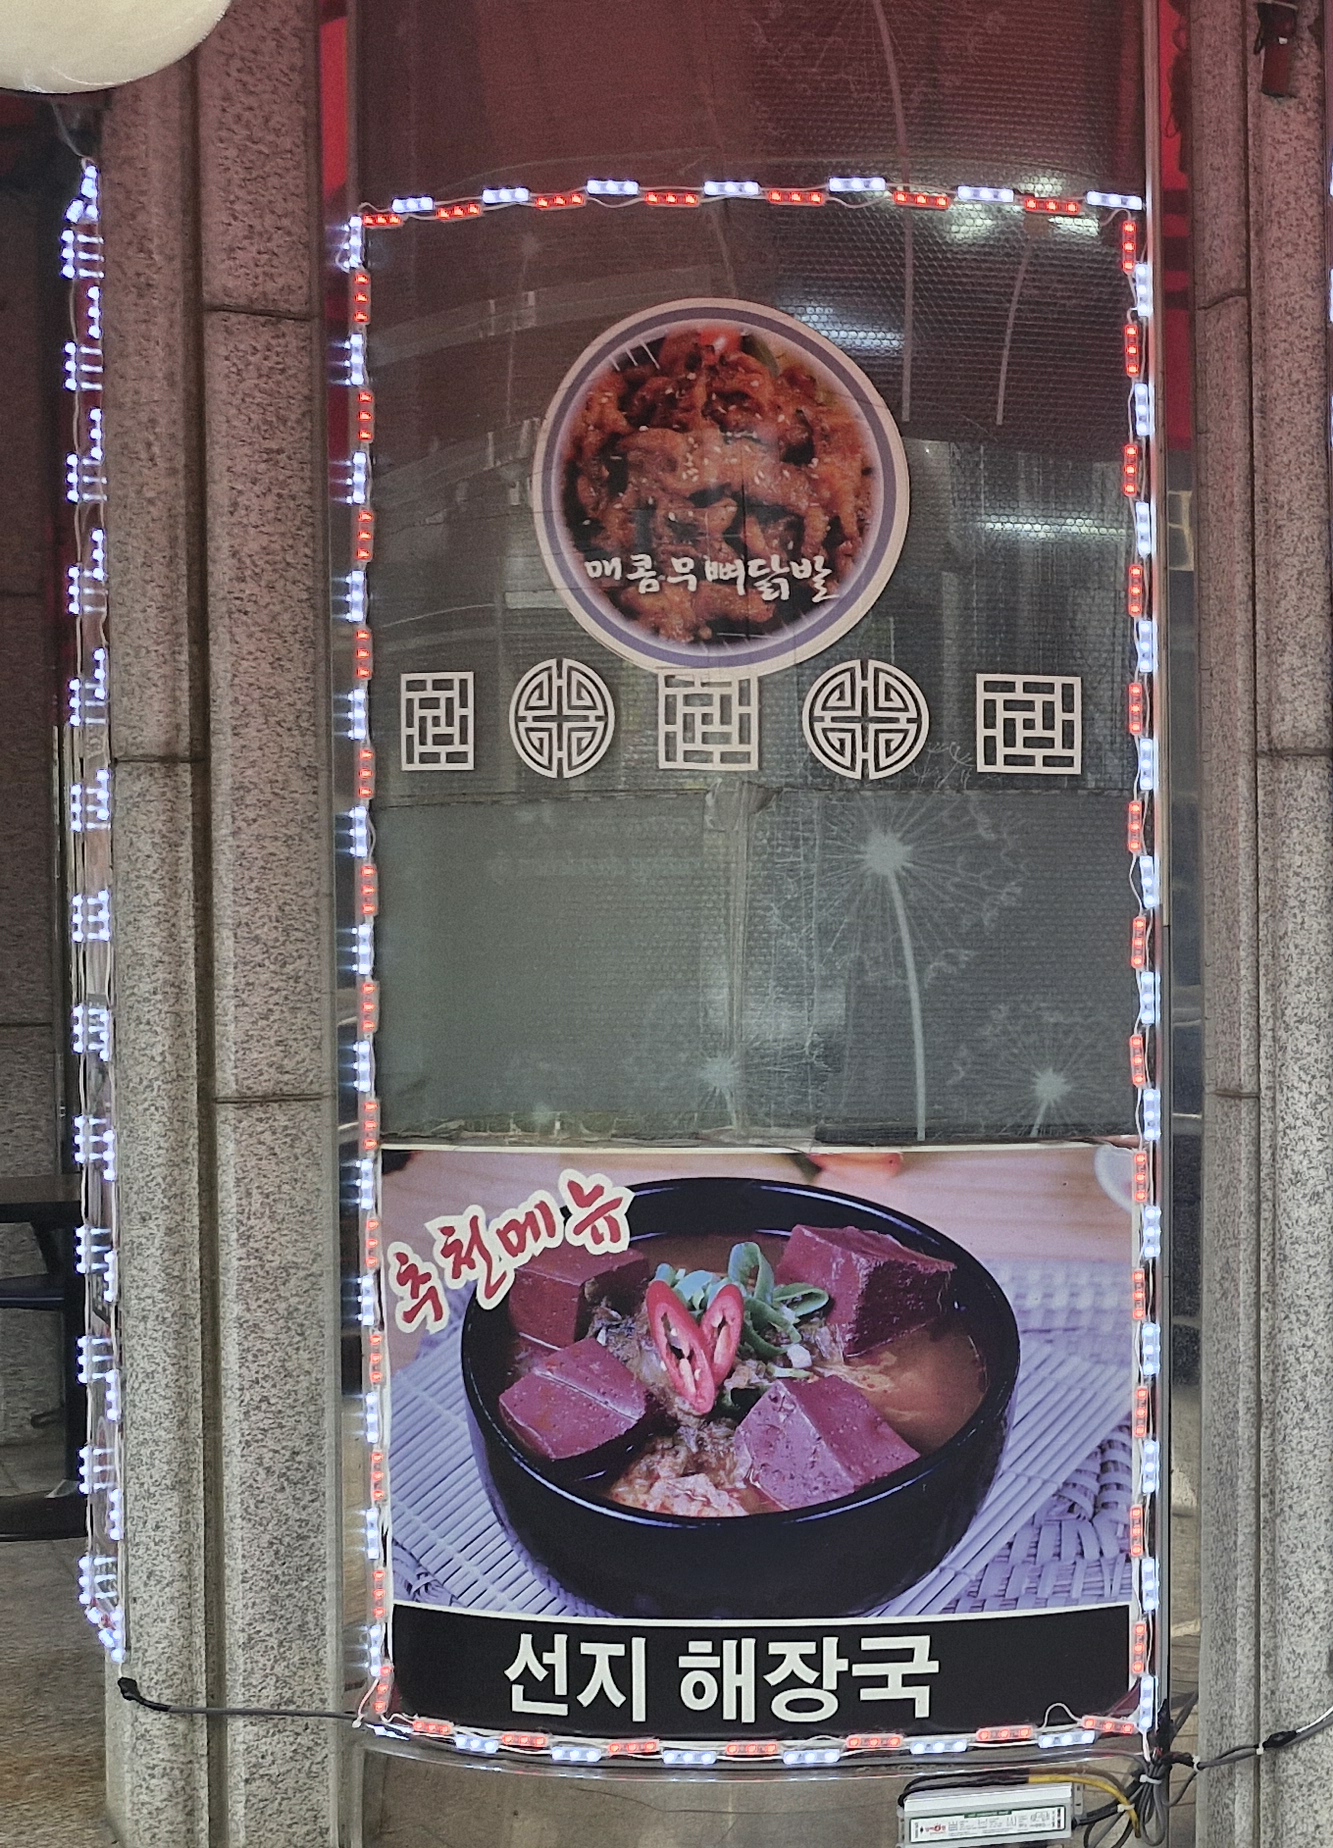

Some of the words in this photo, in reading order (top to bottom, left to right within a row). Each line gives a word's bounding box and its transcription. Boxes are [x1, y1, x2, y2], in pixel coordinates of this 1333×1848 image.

[393, 1171, 633, 1329] 추천메뉴
[503, 1632, 648, 1724] 선지
[678, 1633, 941, 1725] 해장국
